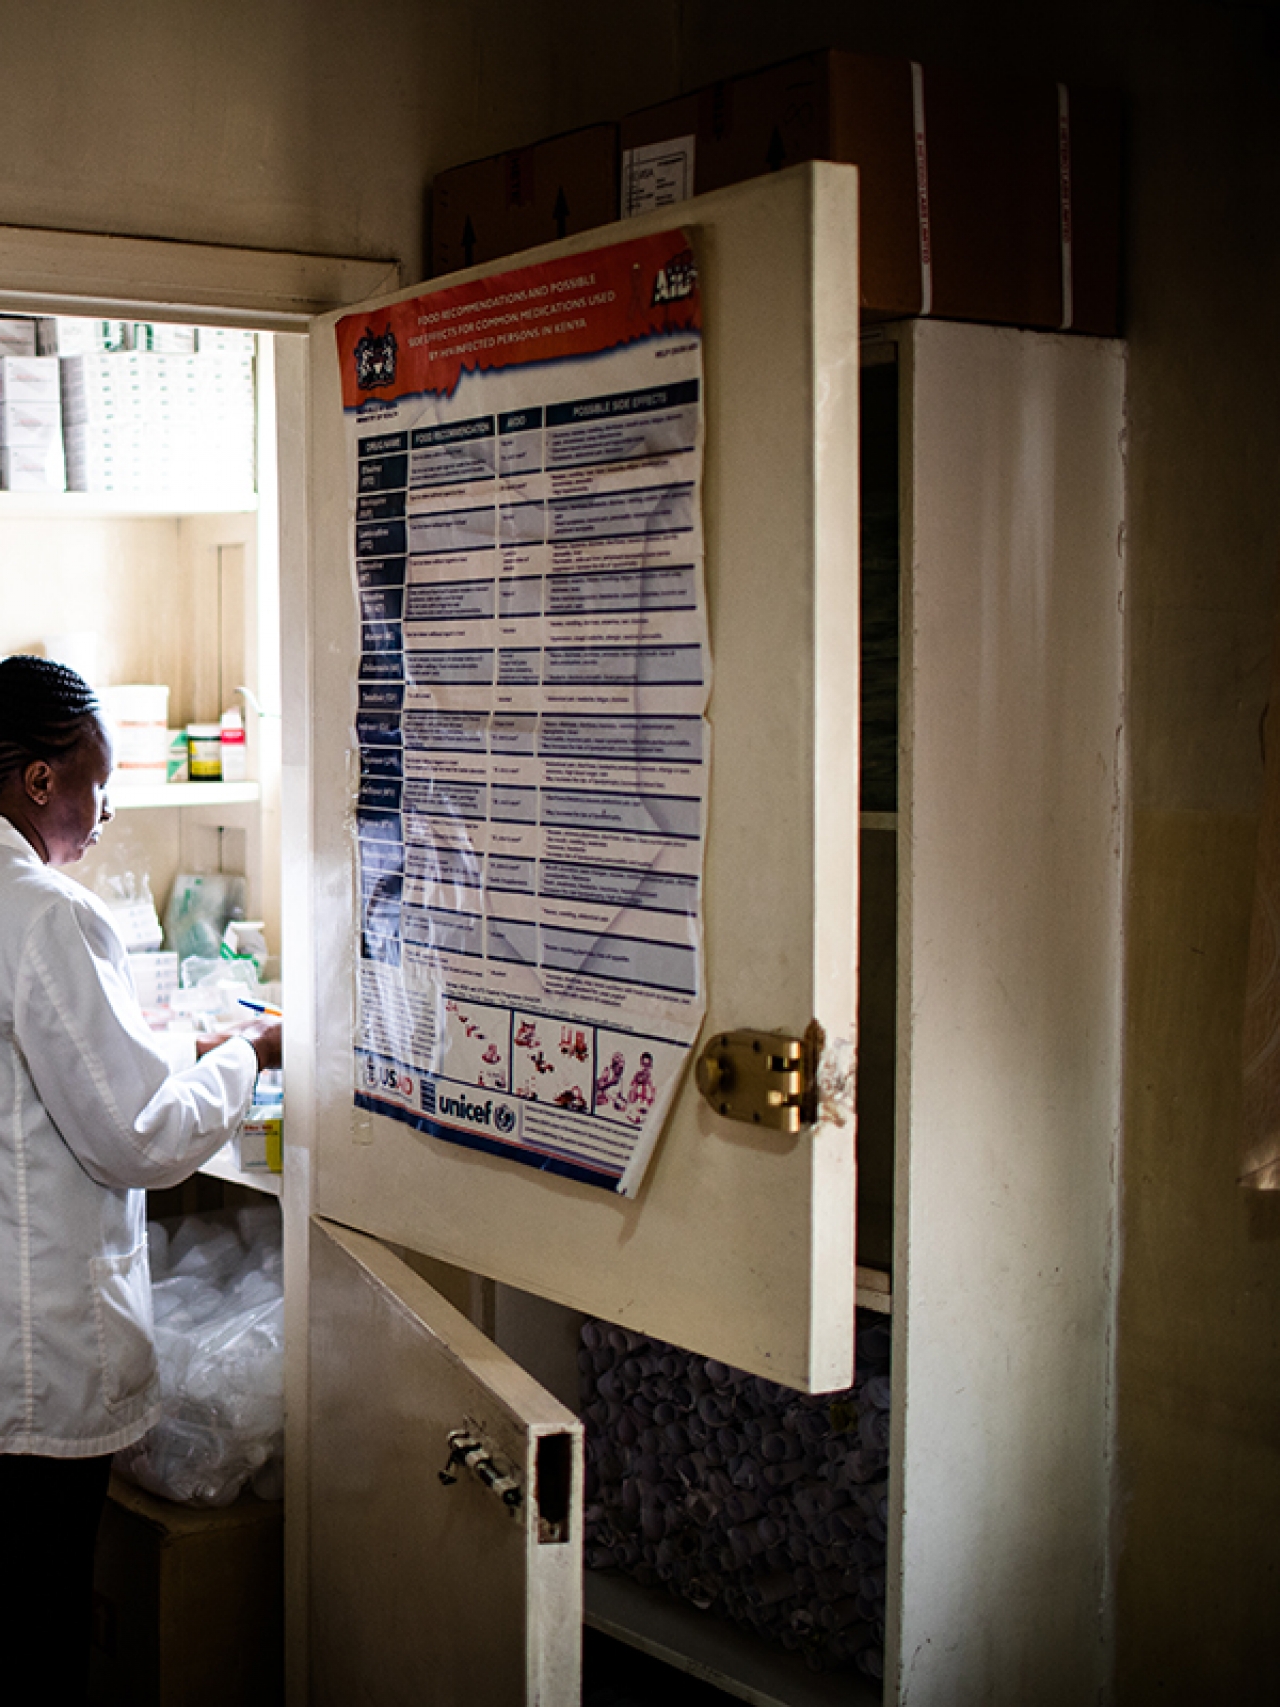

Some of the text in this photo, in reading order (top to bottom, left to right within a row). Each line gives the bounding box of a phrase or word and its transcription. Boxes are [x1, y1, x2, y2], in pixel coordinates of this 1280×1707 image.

[549, 273, 596, 294] POSSIBLE
[475, 311, 519, 332] COMMON
[520, 297, 587, 322] MEDICATIONS
[588, 290, 616, 307] USED
[497, 327, 540, 346] PERSONS
[554, 318, 587, 335] KENYA
[438, 1094, 494, 1125] unicef
